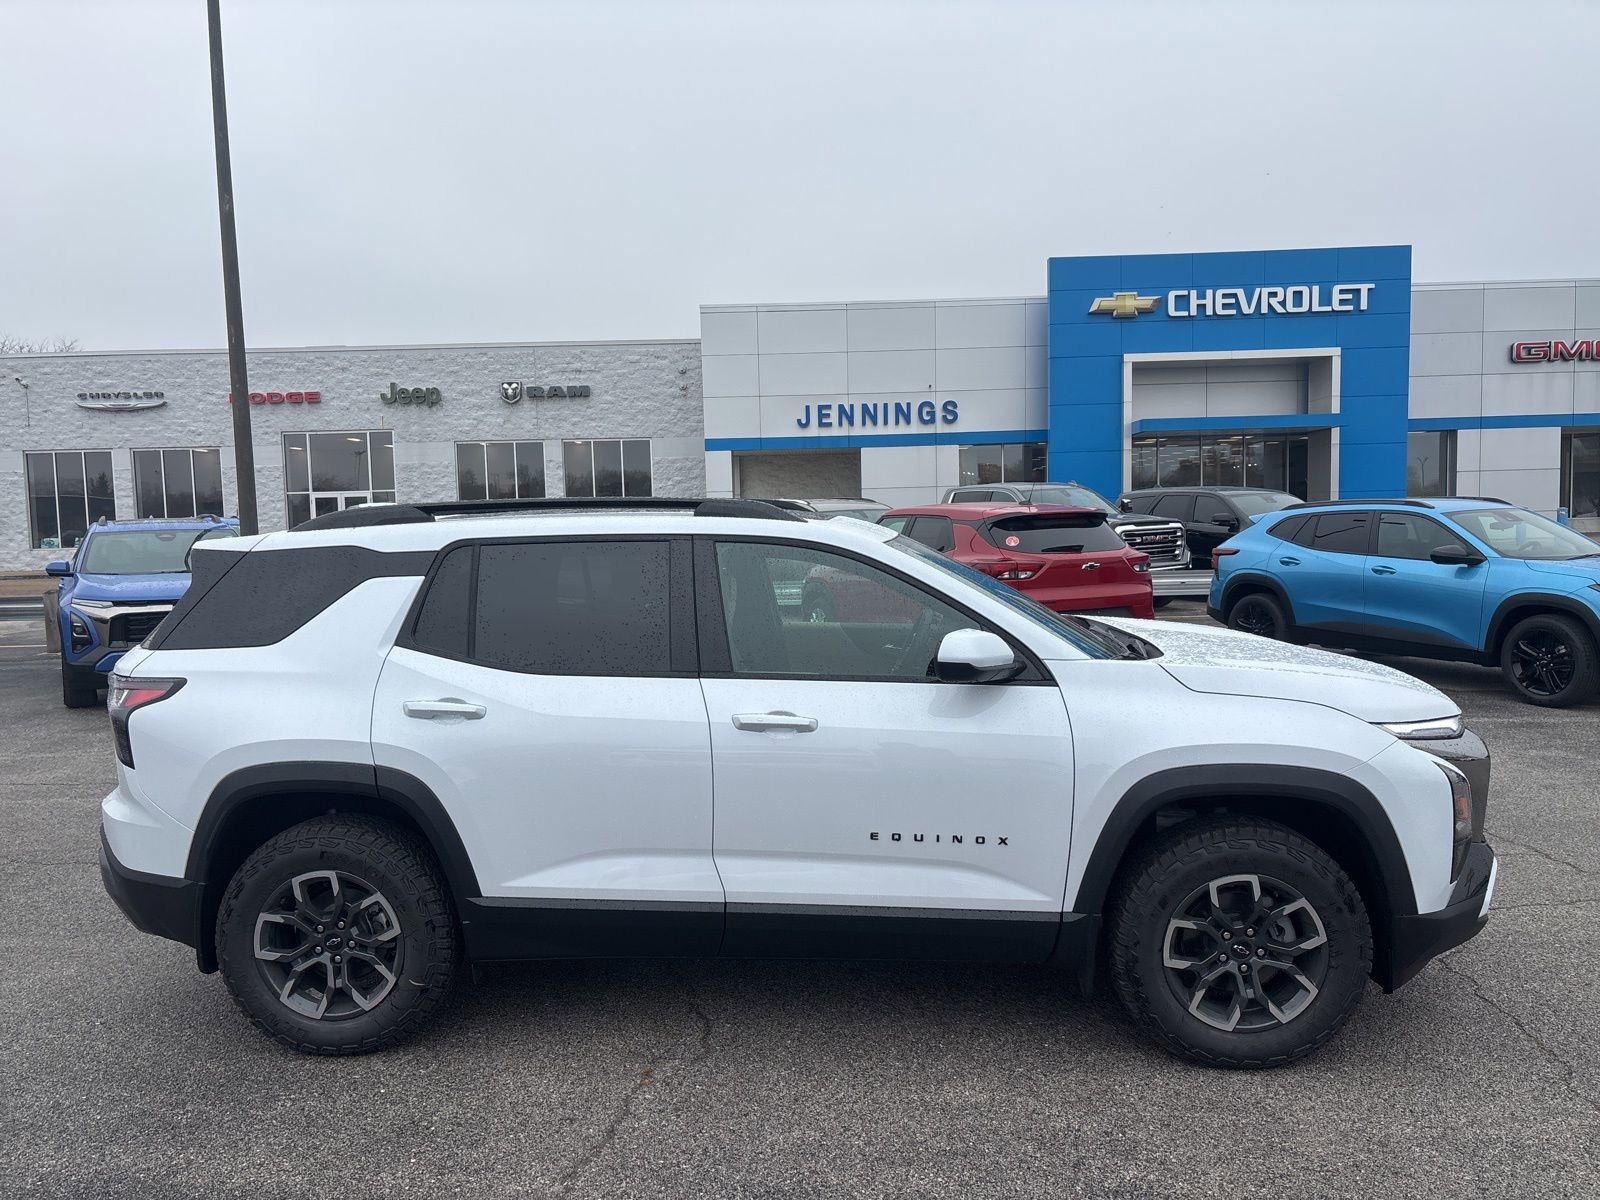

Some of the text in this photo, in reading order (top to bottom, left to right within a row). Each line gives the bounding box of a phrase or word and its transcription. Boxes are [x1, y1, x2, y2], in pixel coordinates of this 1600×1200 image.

[1167, 283, 1376, 317] CHEVROLET
[1511, 339, 1600, 362] GM
[77, 391, 165, 400] CHRYSLER
[379, 382, 442, 408] Jeep
[526, 385, 591, 398] RAM
[796, 399, 959, 428] JENNINGS
[1142, 534, 1169, 544] GMC
[869, 831, 1009, 846] EQUINOX
